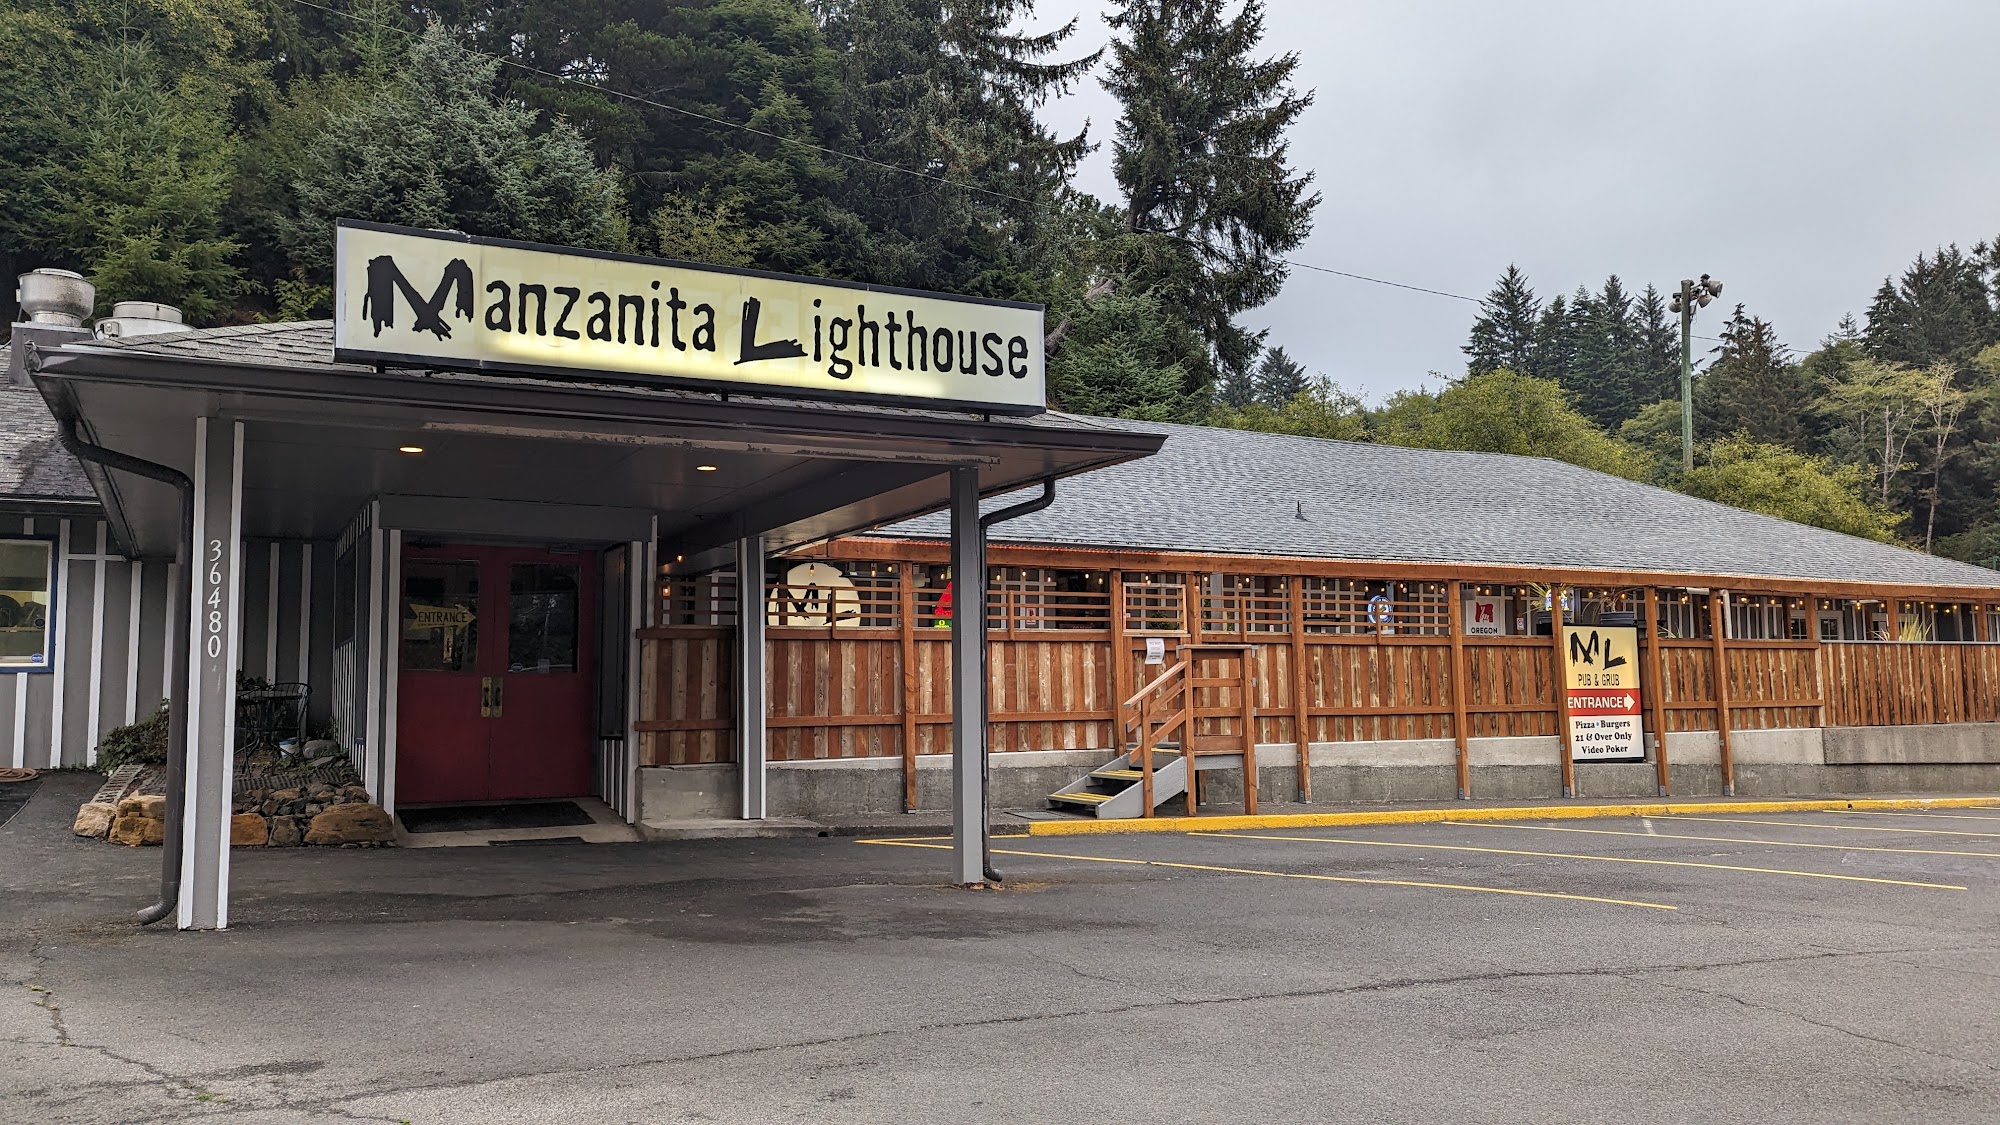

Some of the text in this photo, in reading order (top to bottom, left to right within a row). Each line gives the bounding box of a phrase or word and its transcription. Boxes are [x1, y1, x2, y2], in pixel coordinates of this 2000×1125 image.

[362, 255, 1028, 379] Manzanita Lighthouse
[207, 539, 222, 658] 36480
[418, 611, 468, 623] ENTRANCE
[1470, 626, 1498, 634] OREGON
[1569, 630, 1628, 671] ML
[1577, 673, 1620, 687] PUB & GRUB
[1567, 696, 1624, 709] ENTRANCE
[1575, 719, 1631, 729] Pizza Burgers
[1575, 731, 1632, 742] 21 & Over Only
[1581, 744, 1628, 754] Video Poker
